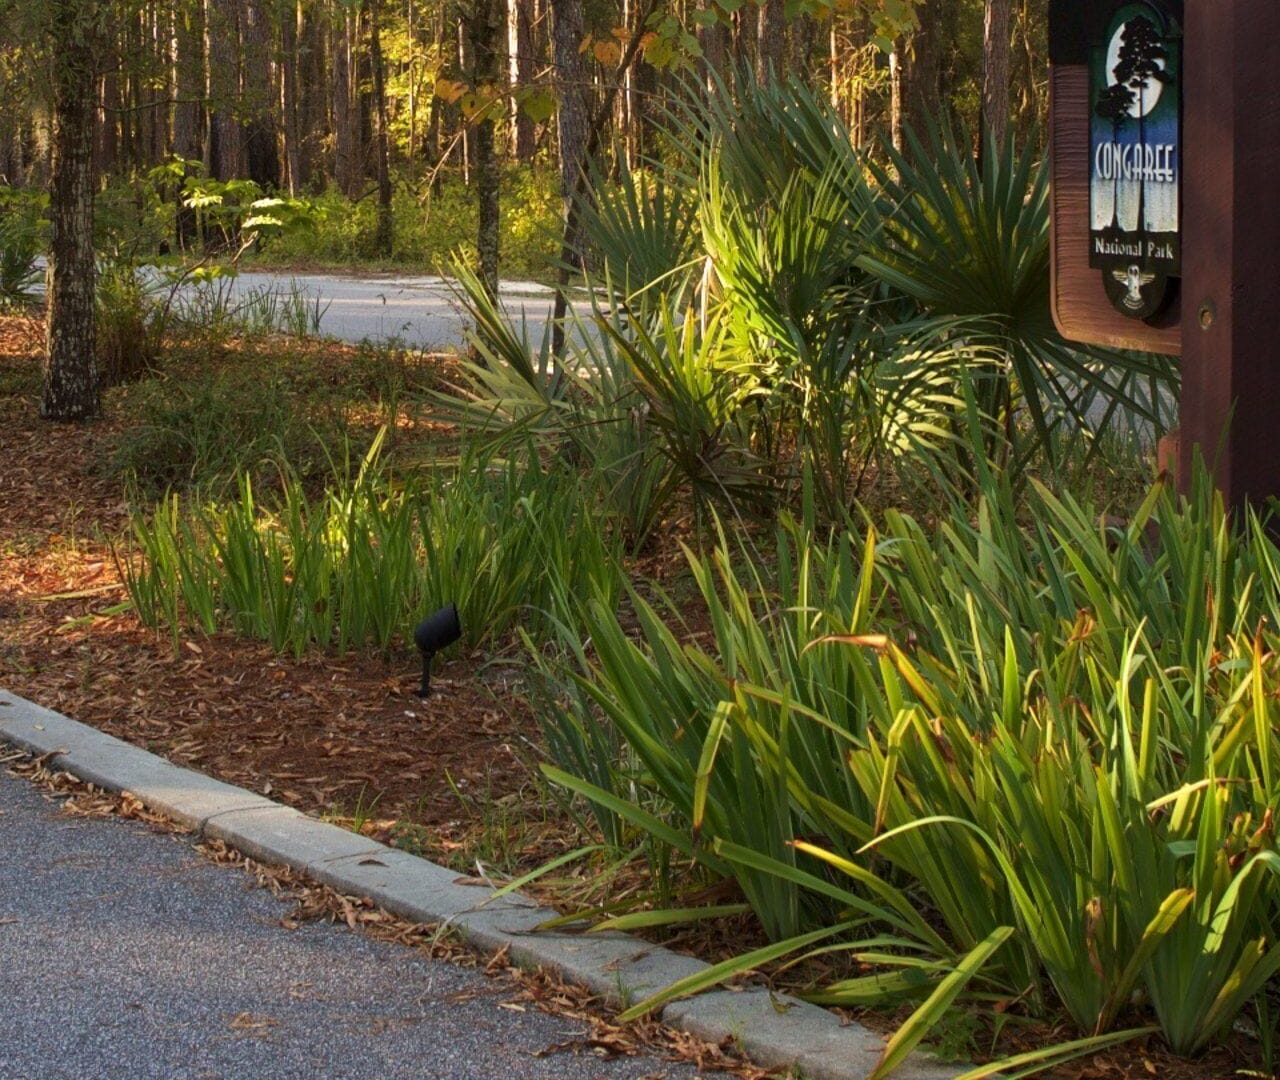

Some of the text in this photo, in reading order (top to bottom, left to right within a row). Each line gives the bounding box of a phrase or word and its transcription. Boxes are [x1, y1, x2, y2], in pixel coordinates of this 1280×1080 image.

[1095, 142, 1173, 182] CONGAREE
[1095, 237, 1174, 259] National Park
